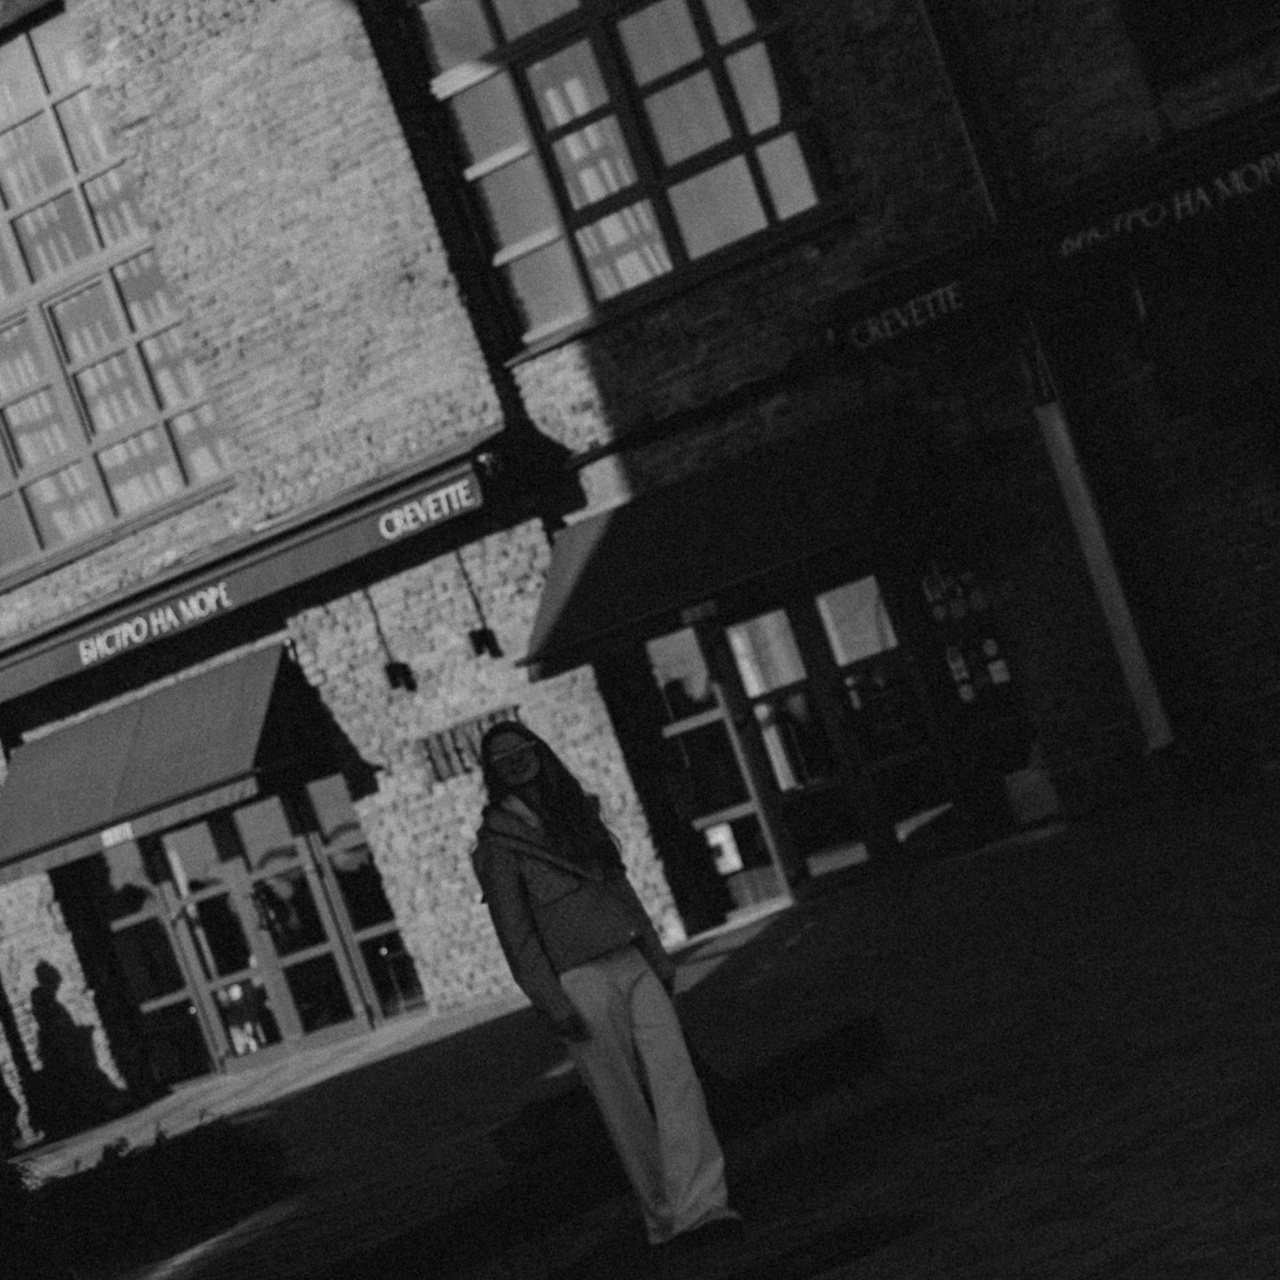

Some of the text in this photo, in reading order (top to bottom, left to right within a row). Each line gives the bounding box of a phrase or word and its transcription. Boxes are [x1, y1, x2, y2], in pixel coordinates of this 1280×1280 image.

[379, 477, 476, 540] CREVETTE
[78, 616, 149, 666] БИСТРО
[149, 605, 181, 637] НА
